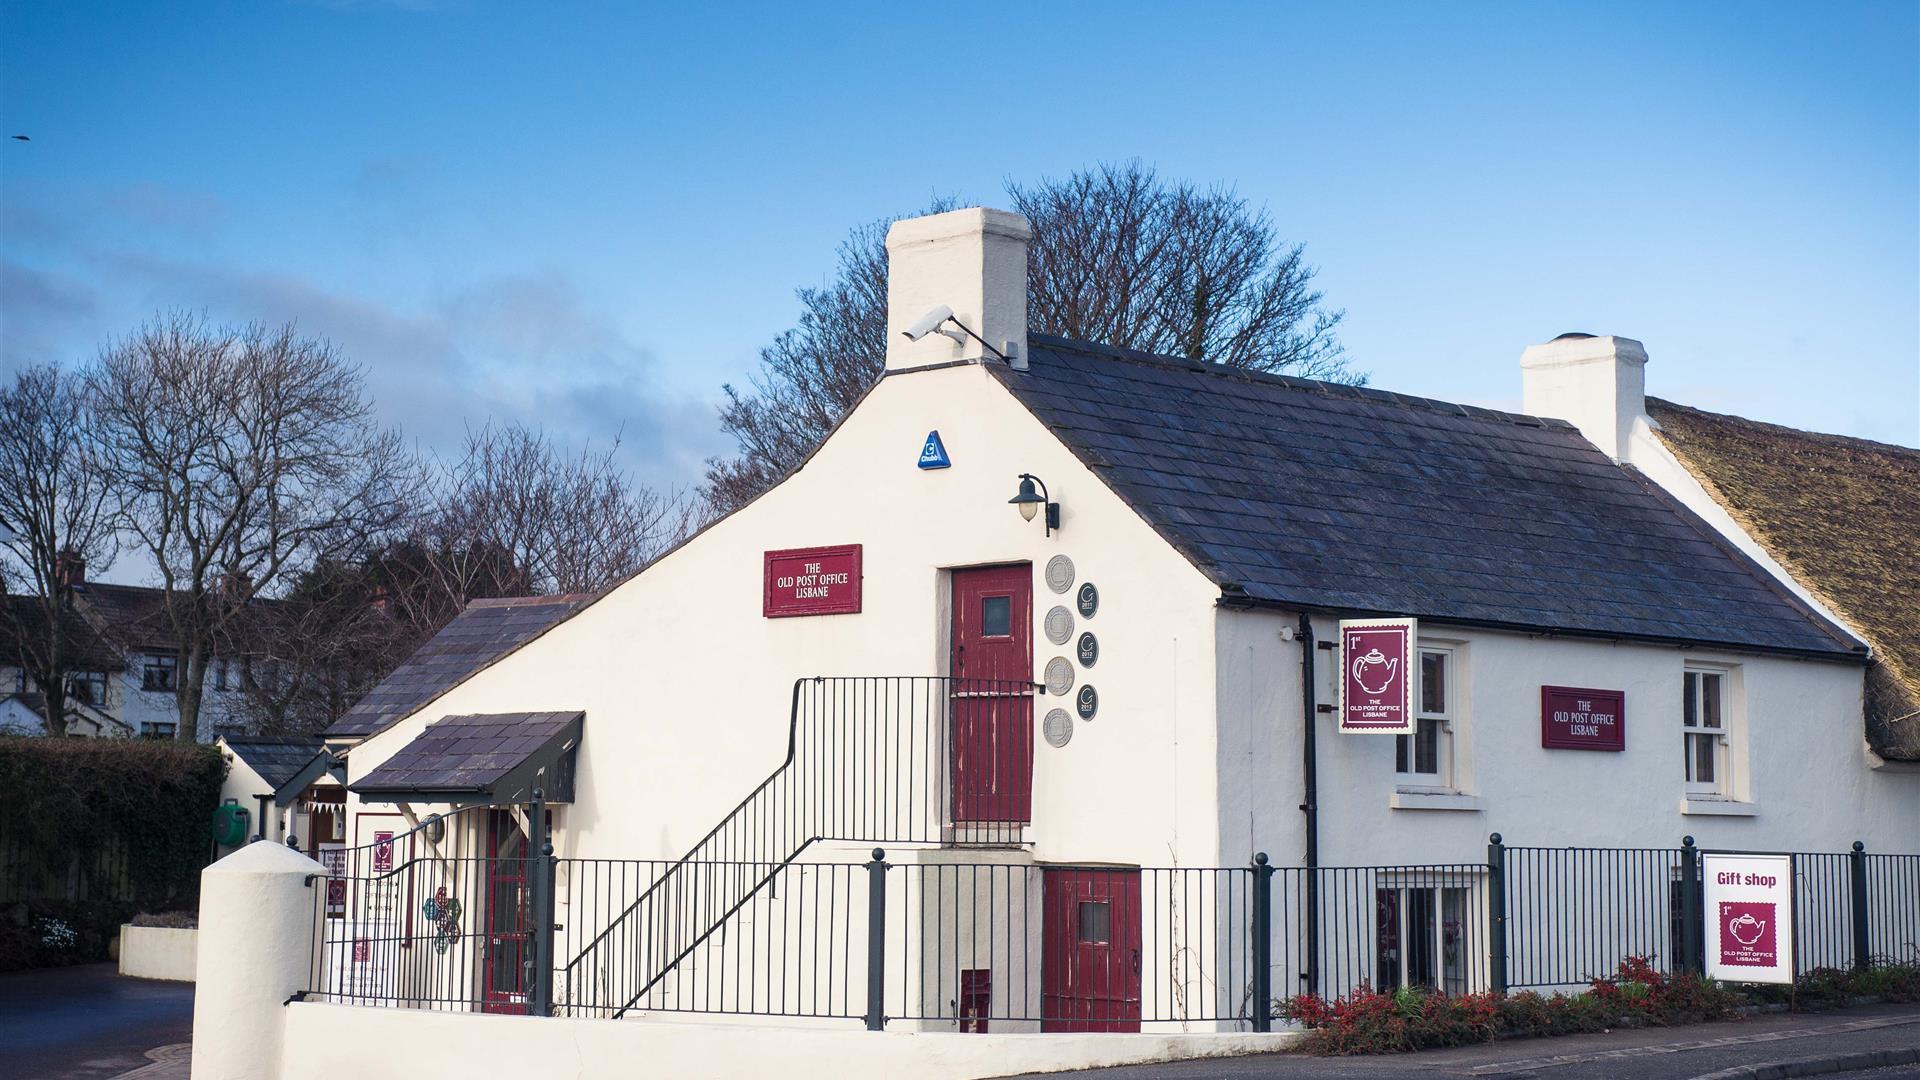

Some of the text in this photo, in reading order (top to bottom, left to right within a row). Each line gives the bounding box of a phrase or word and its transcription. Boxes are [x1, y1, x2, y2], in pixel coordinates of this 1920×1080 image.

[921, 454, 938, 462] Chubb
[804, 563, 820, 574] THE
[777, 573, 848, 588] OLD POST OFFICE
[796, 586, 829, 598] LISBANE
[1350, 636, 1361, 649] 1st
[1577, 701, 1591, 711] THE
[1554, 712, 1614, 725] OLD POST OFFICE
[1571, 725, 1599, 736] LISBANE
[1718, 872, 1776, 888] Gift shop
